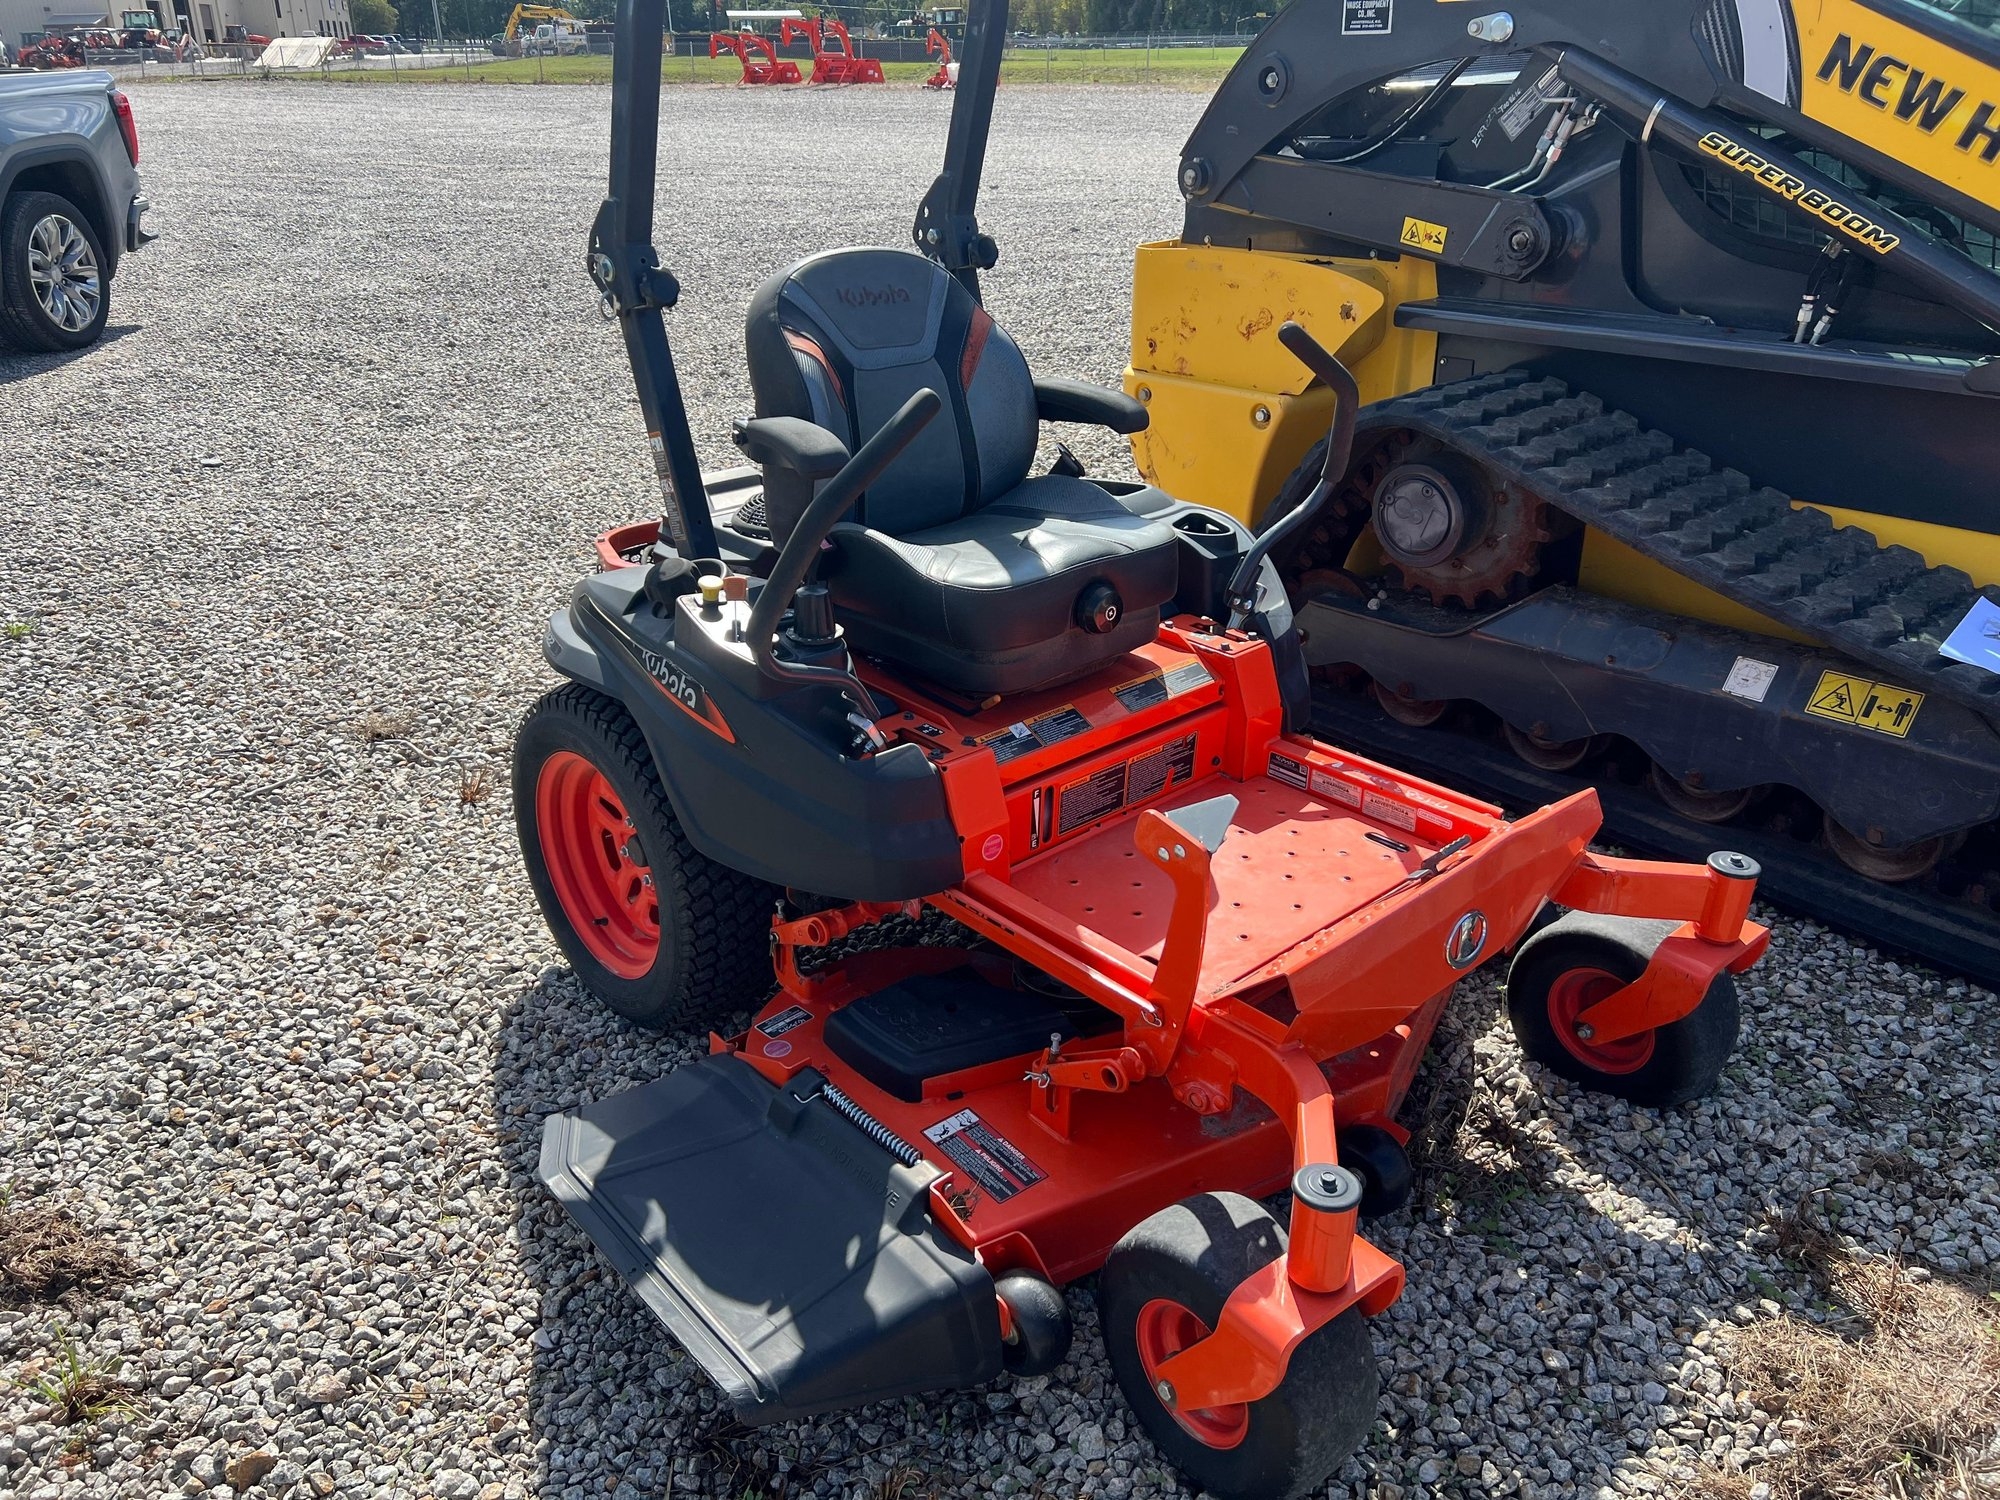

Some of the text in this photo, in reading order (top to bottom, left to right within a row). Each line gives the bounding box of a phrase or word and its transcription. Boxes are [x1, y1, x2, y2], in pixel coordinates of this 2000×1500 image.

[1816, 32, 1967, 135] NEW
[1699, 131, 1900, 254] SUPER BOOM
[836, 284, 911, 307] Kubota
[641, 650, 697, 709] Kubota
[1034, 789, 1040, 798] F
[1002, 1140, 1026, 1161] DANGER
[980, 1152, 1004, 1173] PELIGRO
